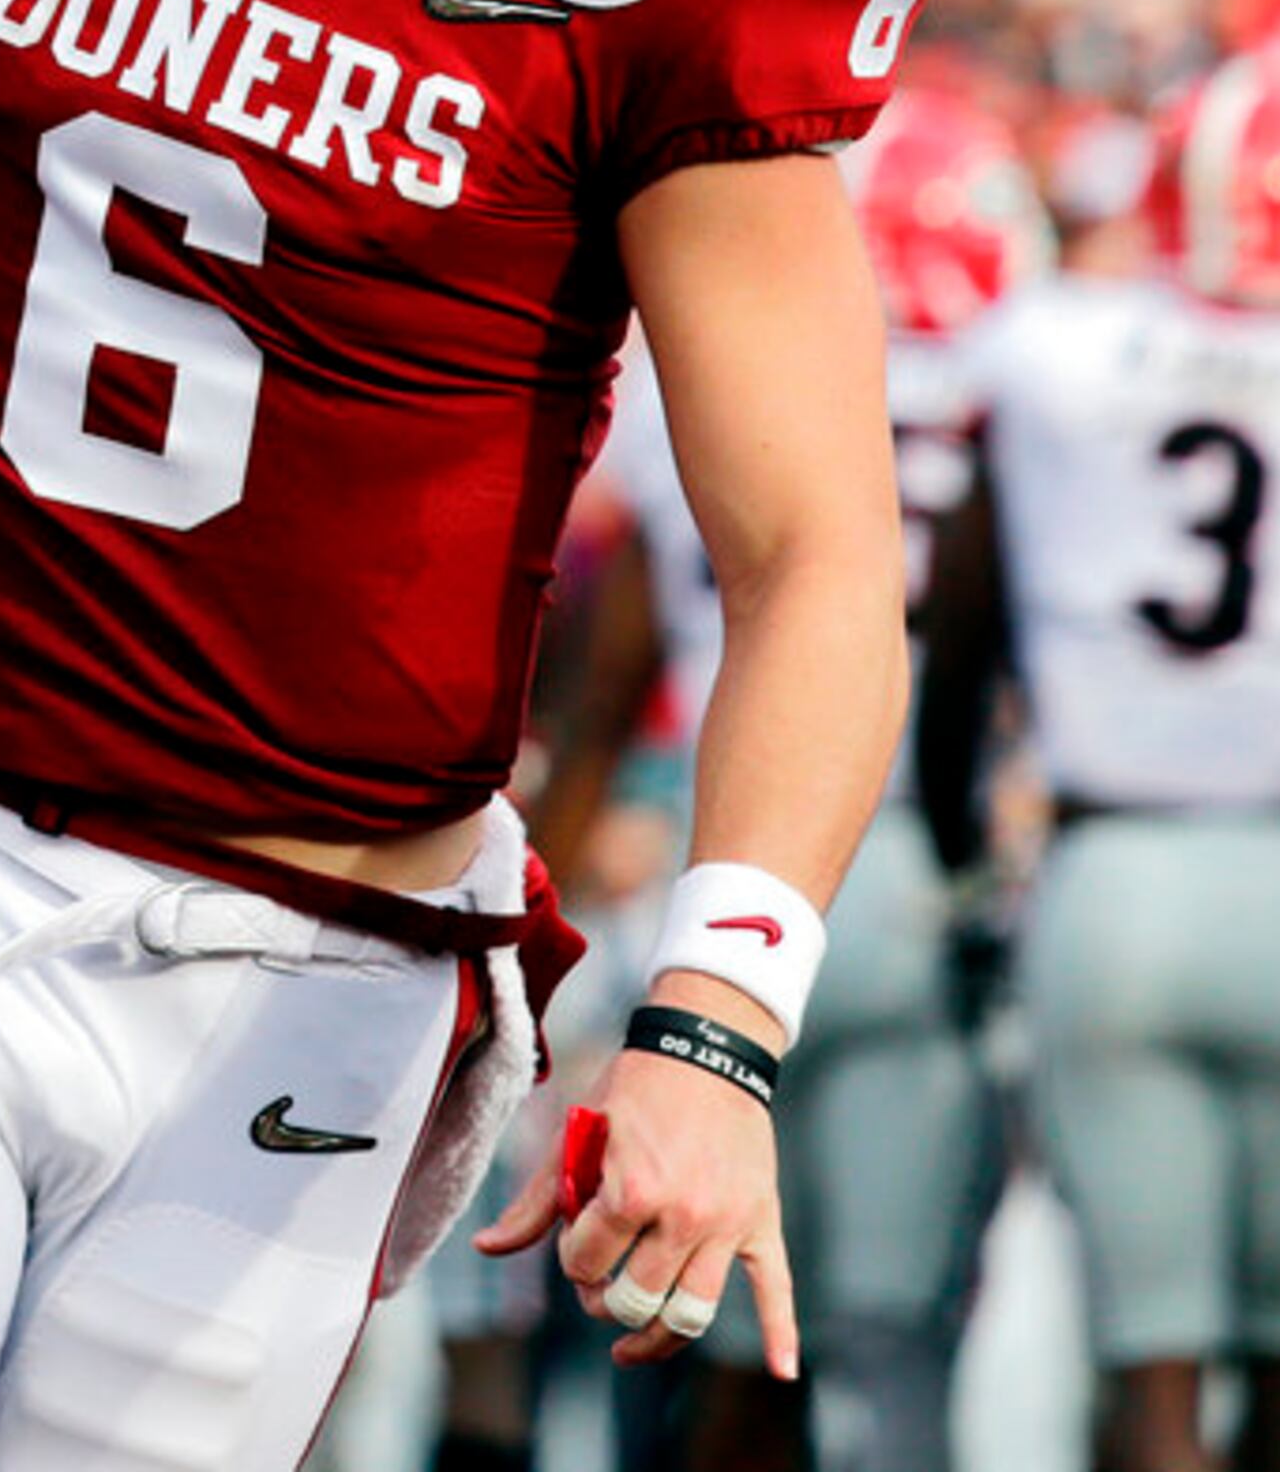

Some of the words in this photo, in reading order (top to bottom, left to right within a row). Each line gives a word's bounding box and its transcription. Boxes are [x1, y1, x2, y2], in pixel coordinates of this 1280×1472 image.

[1132, 418, 1270, 650] 3
[659, 1035, 692, 1056] GO
[694, 1047, 733, 1074] LET
